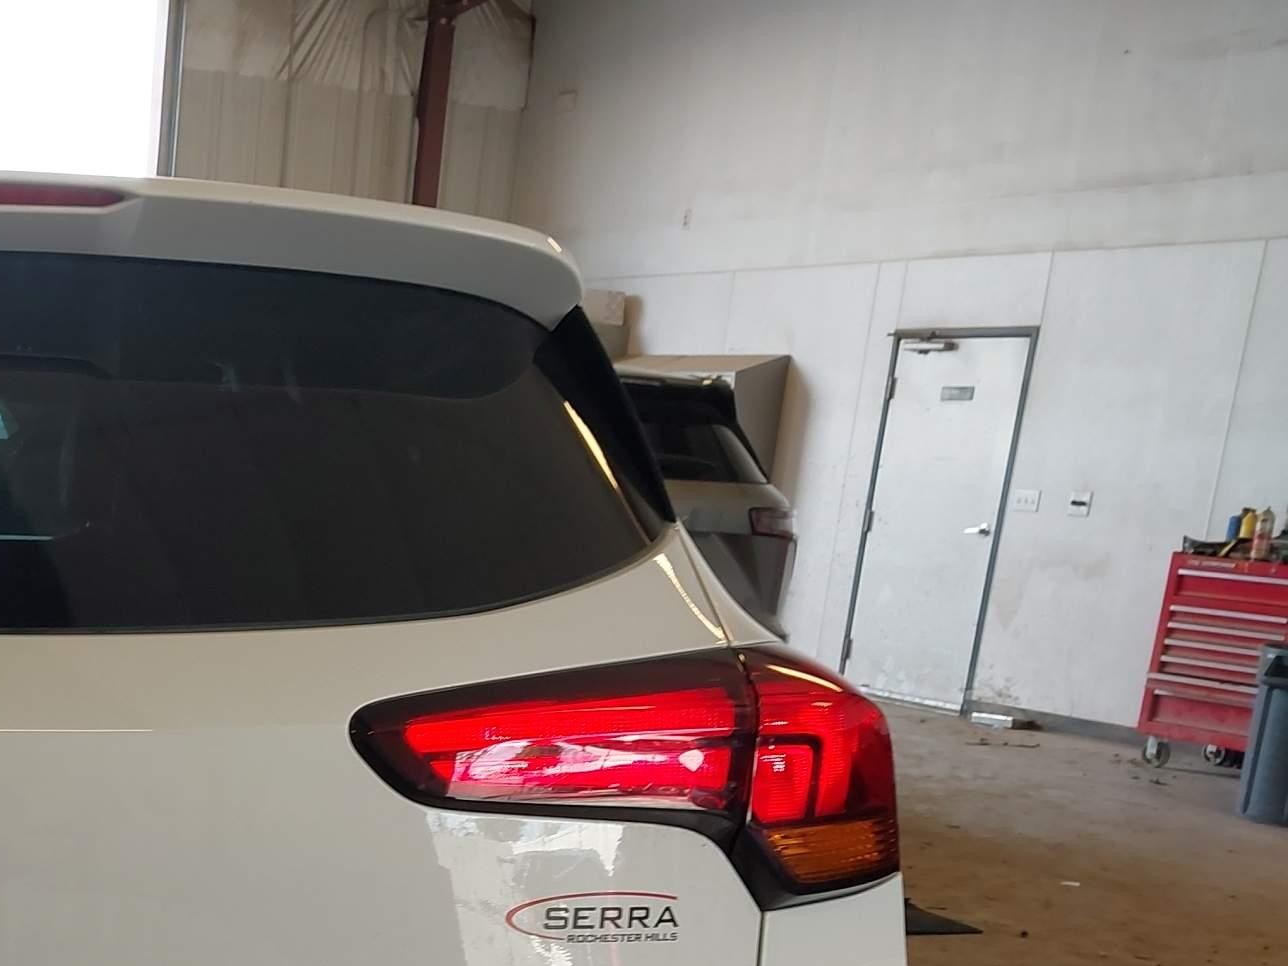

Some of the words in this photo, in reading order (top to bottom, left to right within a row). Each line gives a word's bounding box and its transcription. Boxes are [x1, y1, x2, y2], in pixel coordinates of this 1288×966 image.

[543, 906, 679, 930] SERRA
[566, 933, 642, 944] ROCHESTER
[644, 932, 678, 942] HILLS
